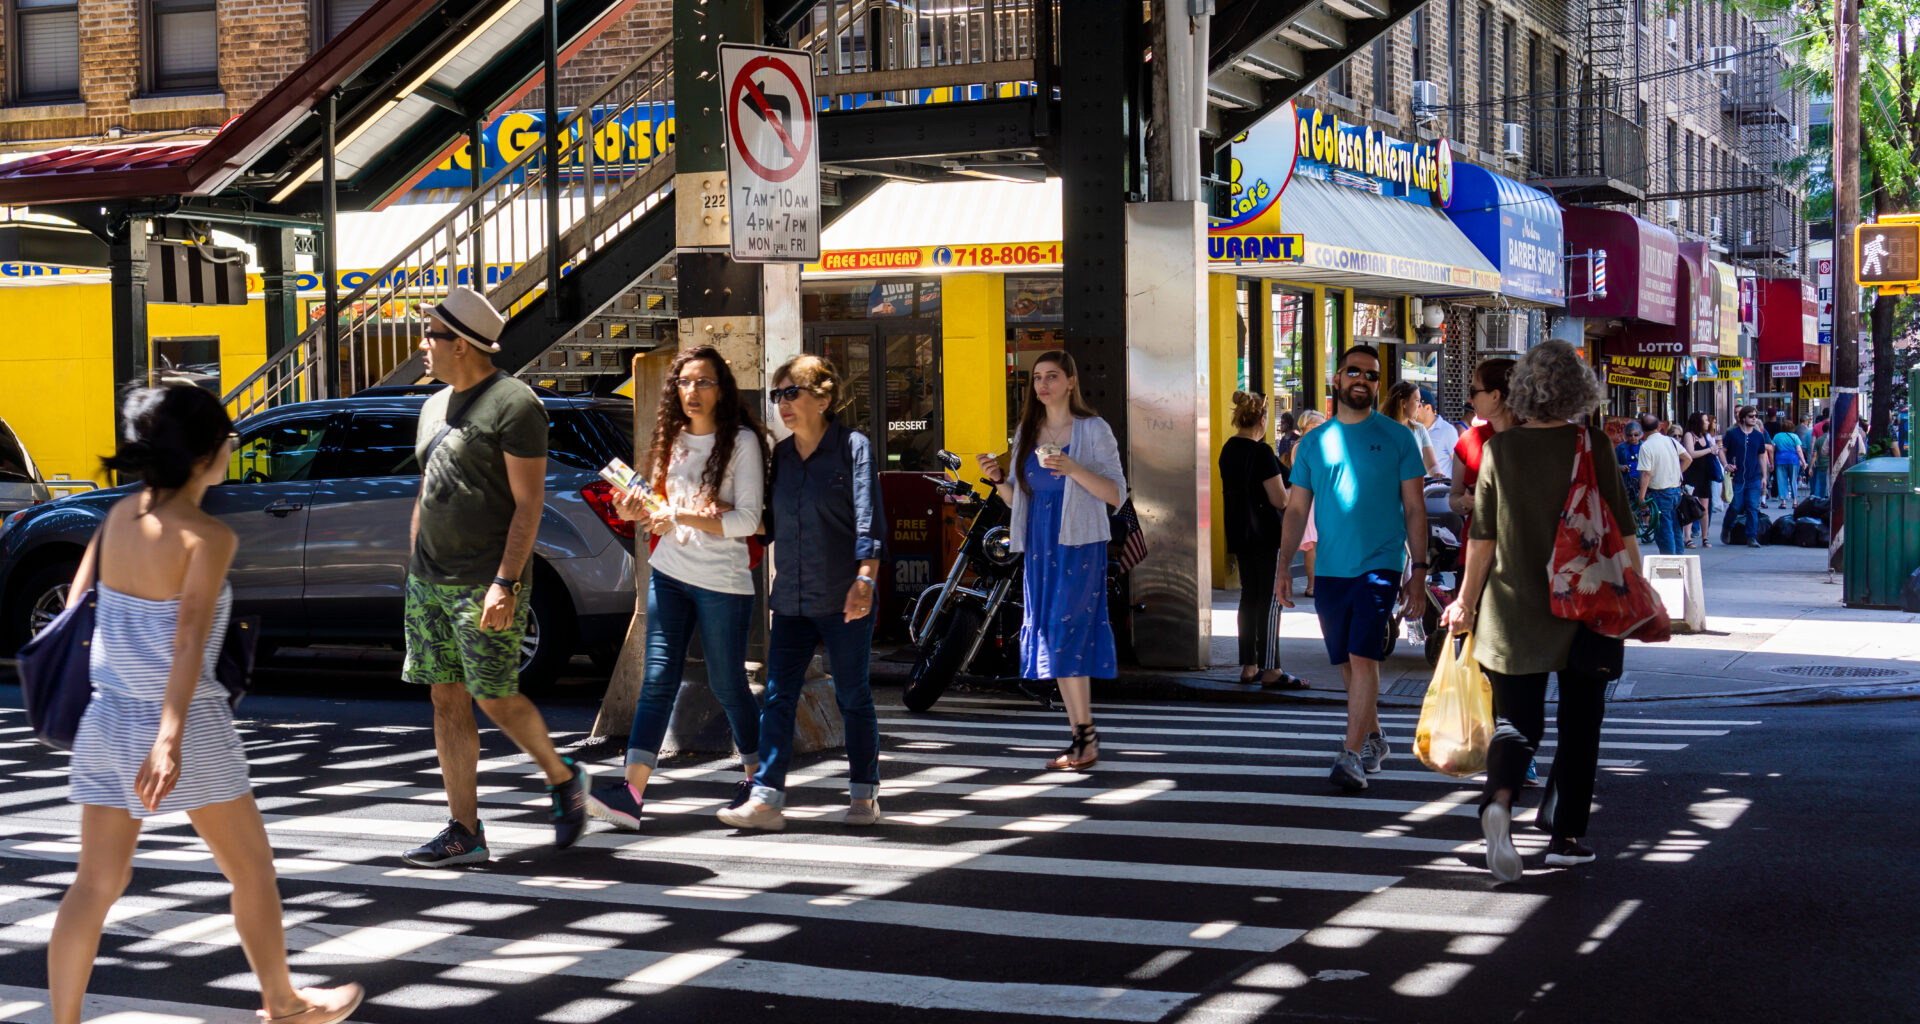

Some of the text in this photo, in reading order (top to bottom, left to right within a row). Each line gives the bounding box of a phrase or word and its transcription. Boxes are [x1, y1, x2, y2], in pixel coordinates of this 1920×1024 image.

[1312, 108, 1363, 172] Golosa
[1366, 126, 1411, 197] Bakery
[1413, 142, 1437, 192] Café
[704, 194, 726, 208] 222
[748, 237, 806, 252] MON THRU FRI
[826, 250, 918, 269] FREE DELIVERY
[954, 244, 1063, 266] 718-806-1
[1508, 238, 1555, 276] BARBER SHOP
[1315, 246, 1388, 274] COLOMBIAN
[1391, 257, 1451, 285] RESTAURANT
[1639, 342, 1683, 352] LOTTO
[1612, 356, 1674, 373] WE BUY GOLD
[1718, 360, 1742, 368] ATION
[1611, 375, 1668, 390] COMPRAMOS ORO
[888, 420, 928, 431] DESSERT
[896, 519, 927, 530] FREE
[894, 530, 929, 541] DAILY
[895, 559, 930, 583] am
